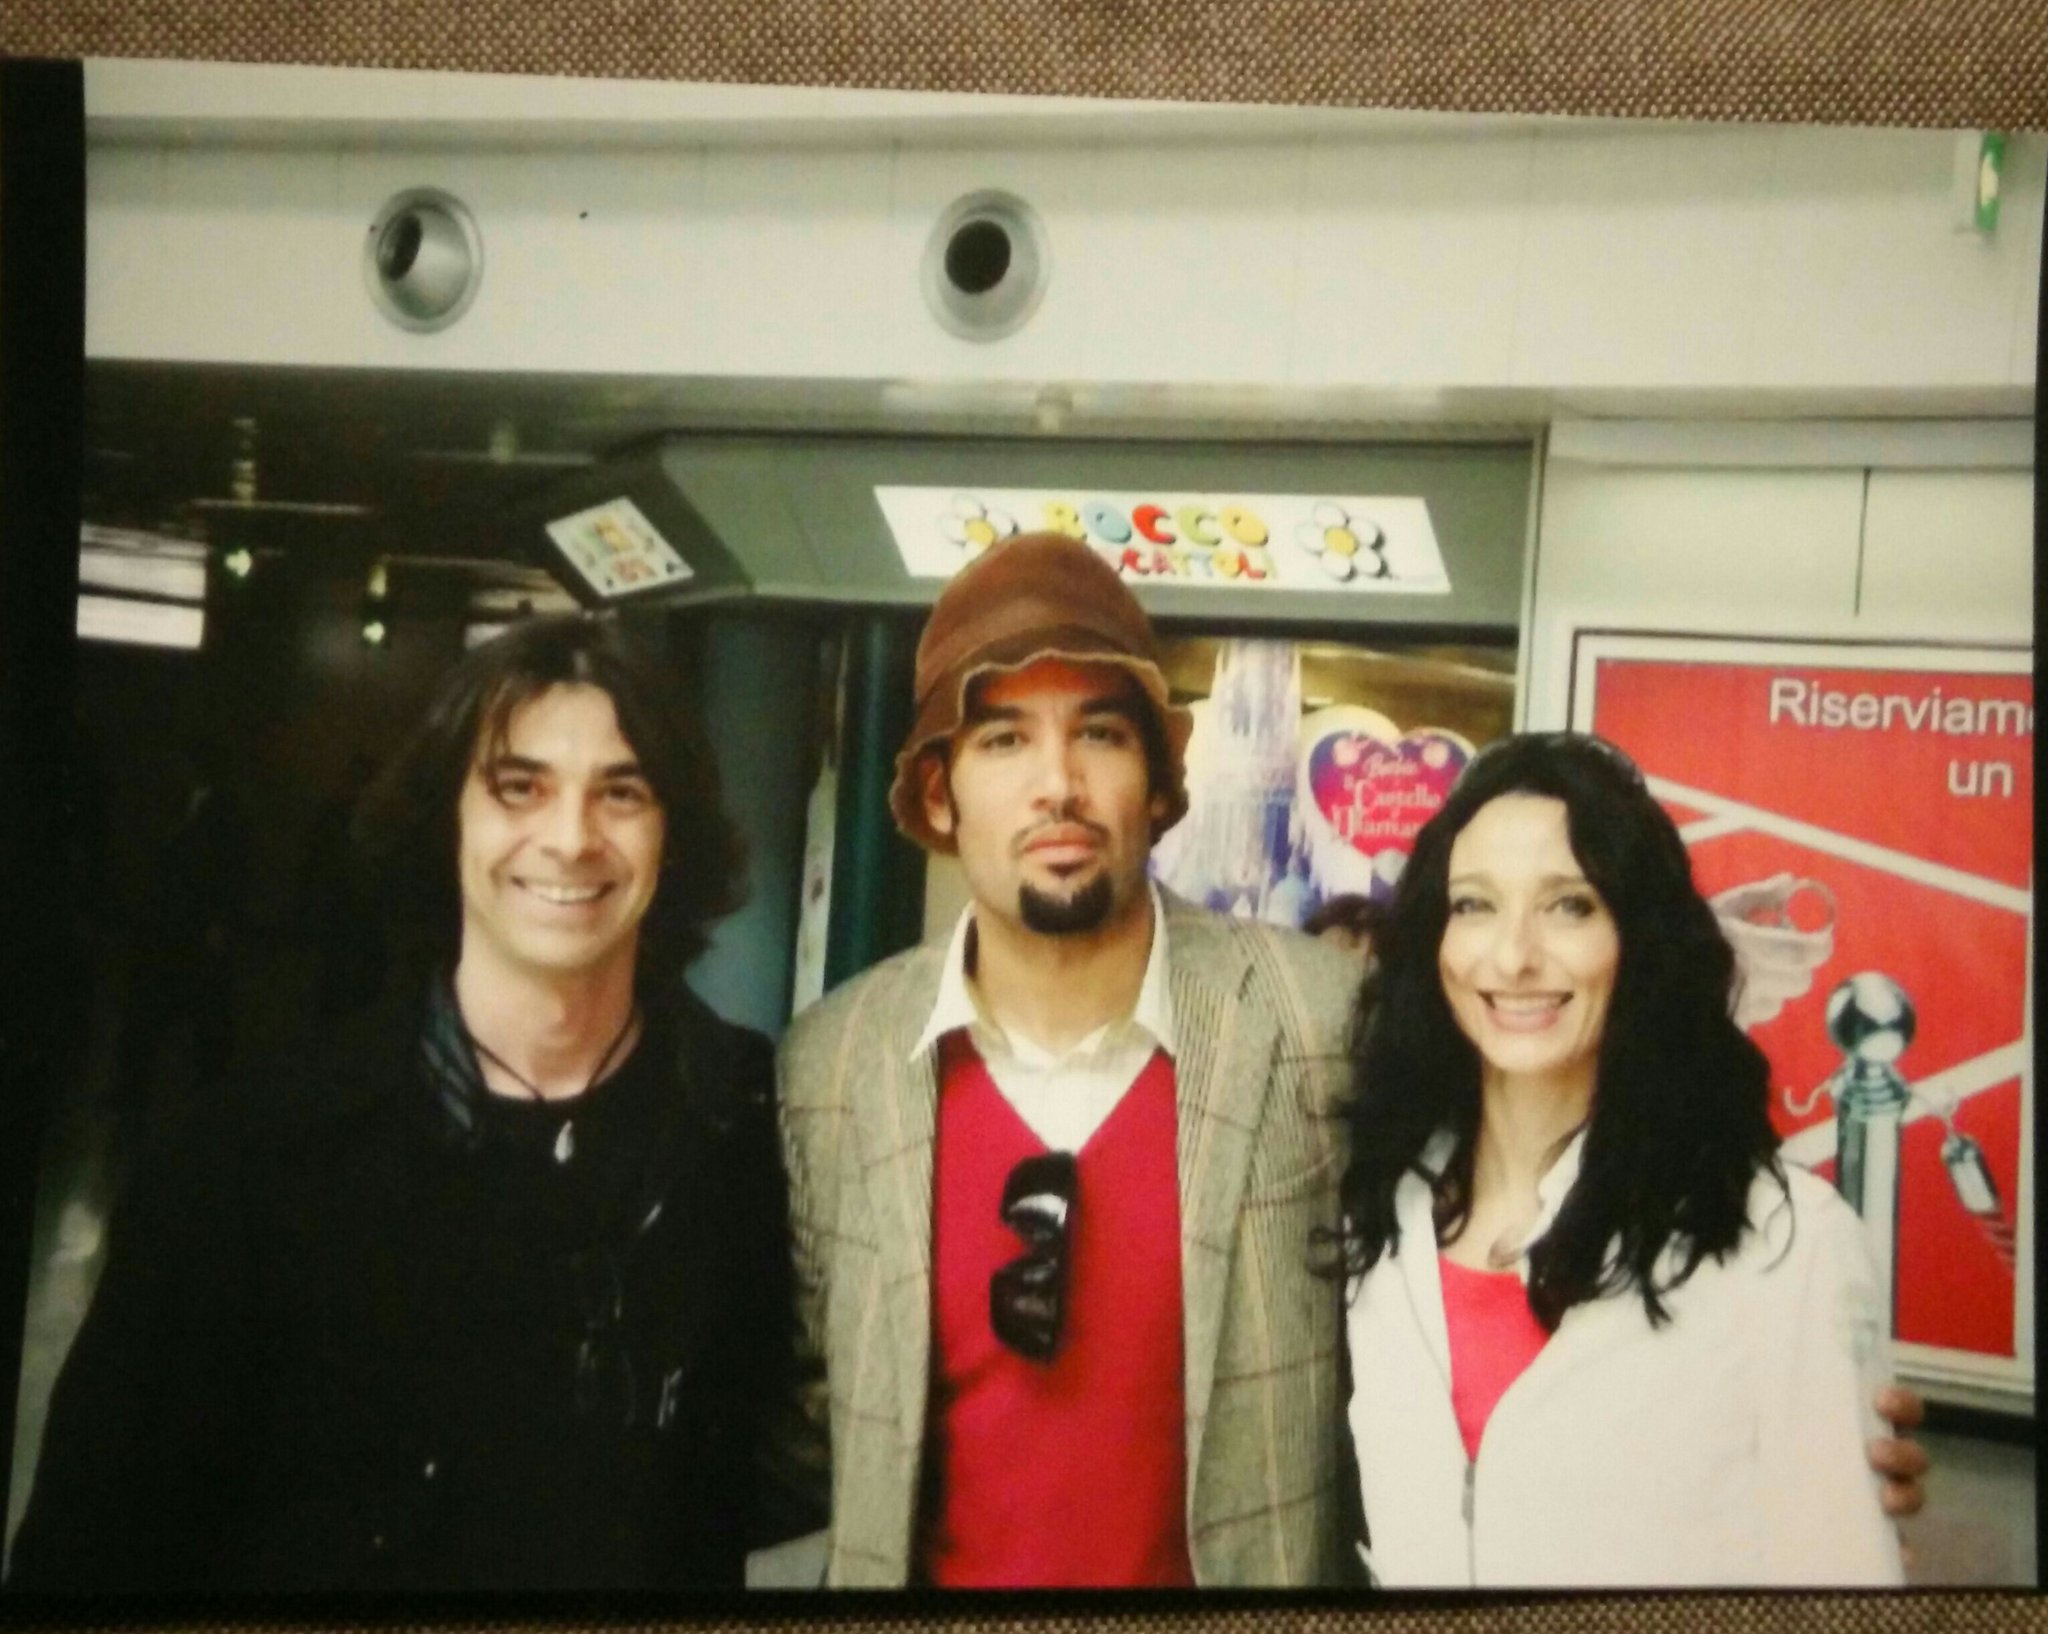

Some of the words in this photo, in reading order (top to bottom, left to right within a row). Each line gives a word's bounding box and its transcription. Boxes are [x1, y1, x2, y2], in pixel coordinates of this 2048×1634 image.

[1042, 501, 1269, 547] ROCCO
[1106, 547, 1278, 579] CATTOLI
[1947, 759, 2015, 798] un
